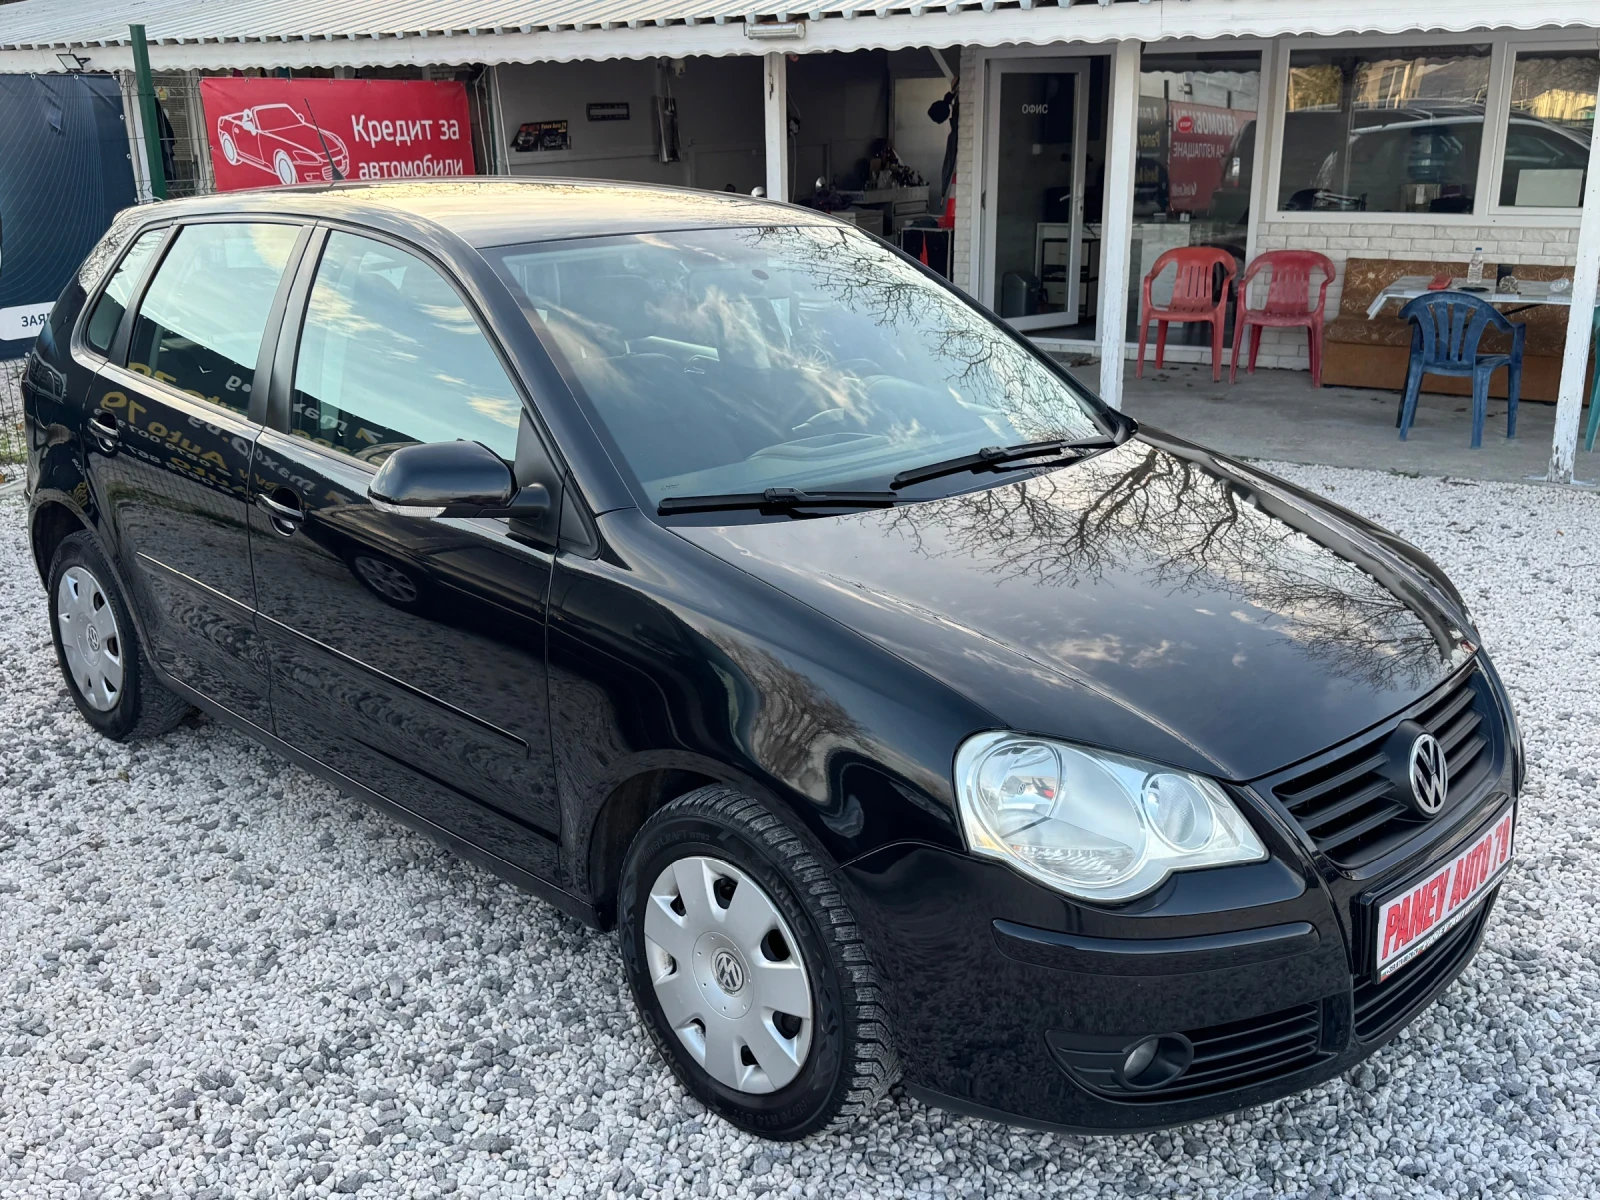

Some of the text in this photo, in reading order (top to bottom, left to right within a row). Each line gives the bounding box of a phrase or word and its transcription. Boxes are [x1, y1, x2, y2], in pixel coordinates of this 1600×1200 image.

[1021, 103, 1048, 115] ОФИС
[351, 114, 460, 148] Кредит за
[358, 153, 464, 180] автомобили
[21, 312, 51, 328] ЗАЯ
[1382, 867, 1450, 961] PANEV
[1447, 833, 1492, 912] AUTO
[1491, 815, 1511, 873] 79
